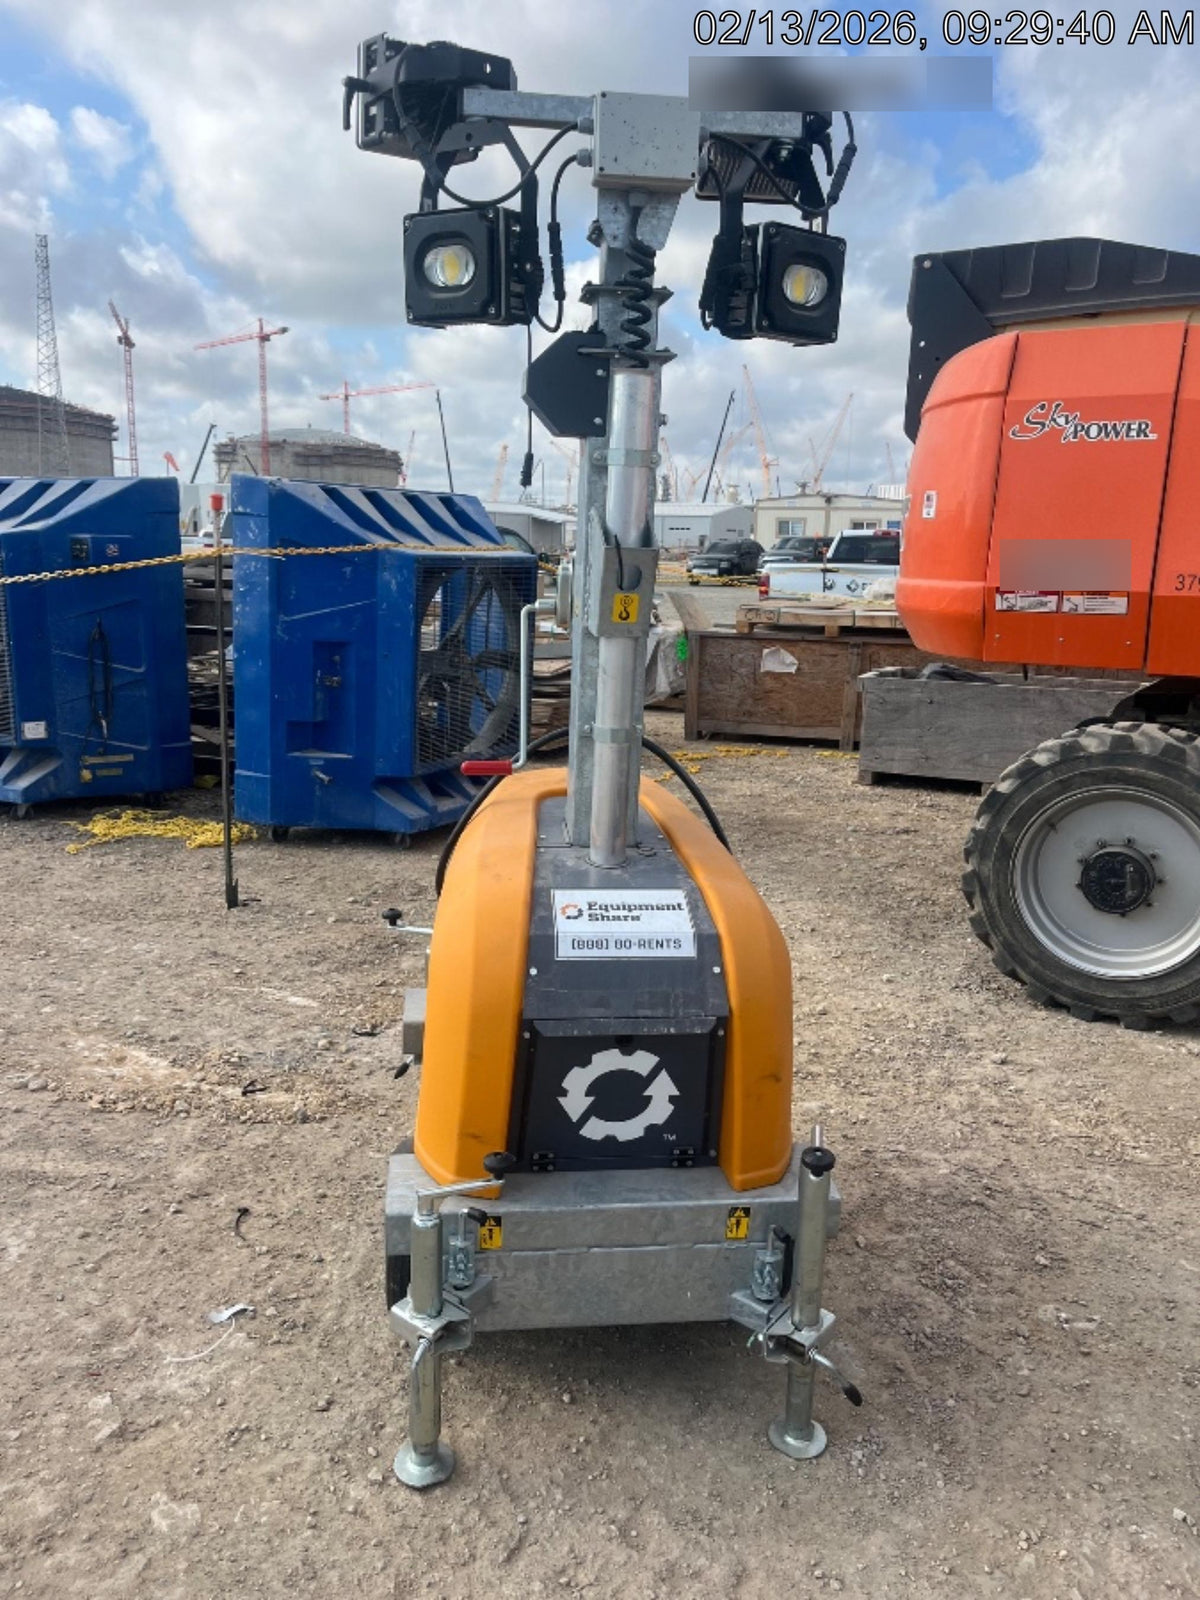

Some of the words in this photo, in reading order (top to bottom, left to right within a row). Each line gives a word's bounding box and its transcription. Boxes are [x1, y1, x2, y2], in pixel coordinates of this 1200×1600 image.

[1174, 573, 1200, 592] 37
[587, 901, 685, 913] Equipment
[588, 912, 641, 922] Share
